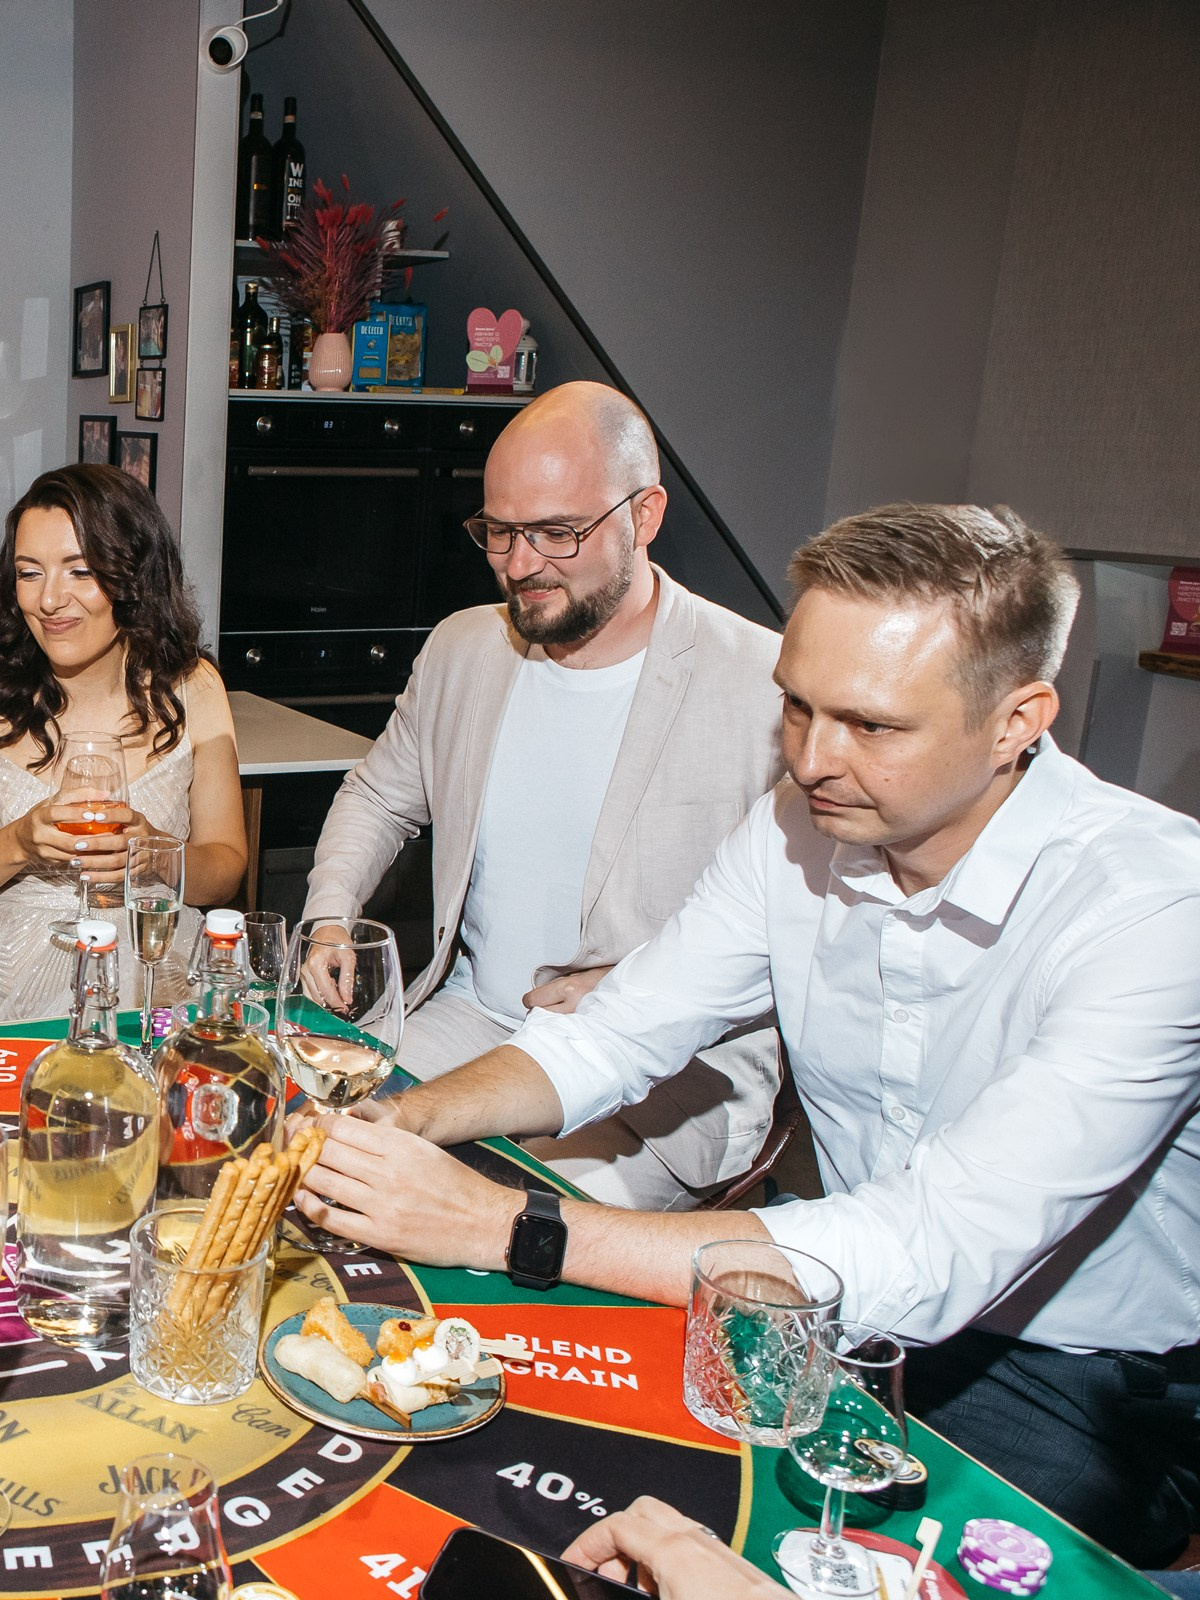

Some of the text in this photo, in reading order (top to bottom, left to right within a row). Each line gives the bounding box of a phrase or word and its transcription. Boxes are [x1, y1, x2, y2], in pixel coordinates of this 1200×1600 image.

[290, 162, 304, 177] W
[502, 1358, 639, 1390] GRAIN
[496, 1462, 607, 1516] 40%
